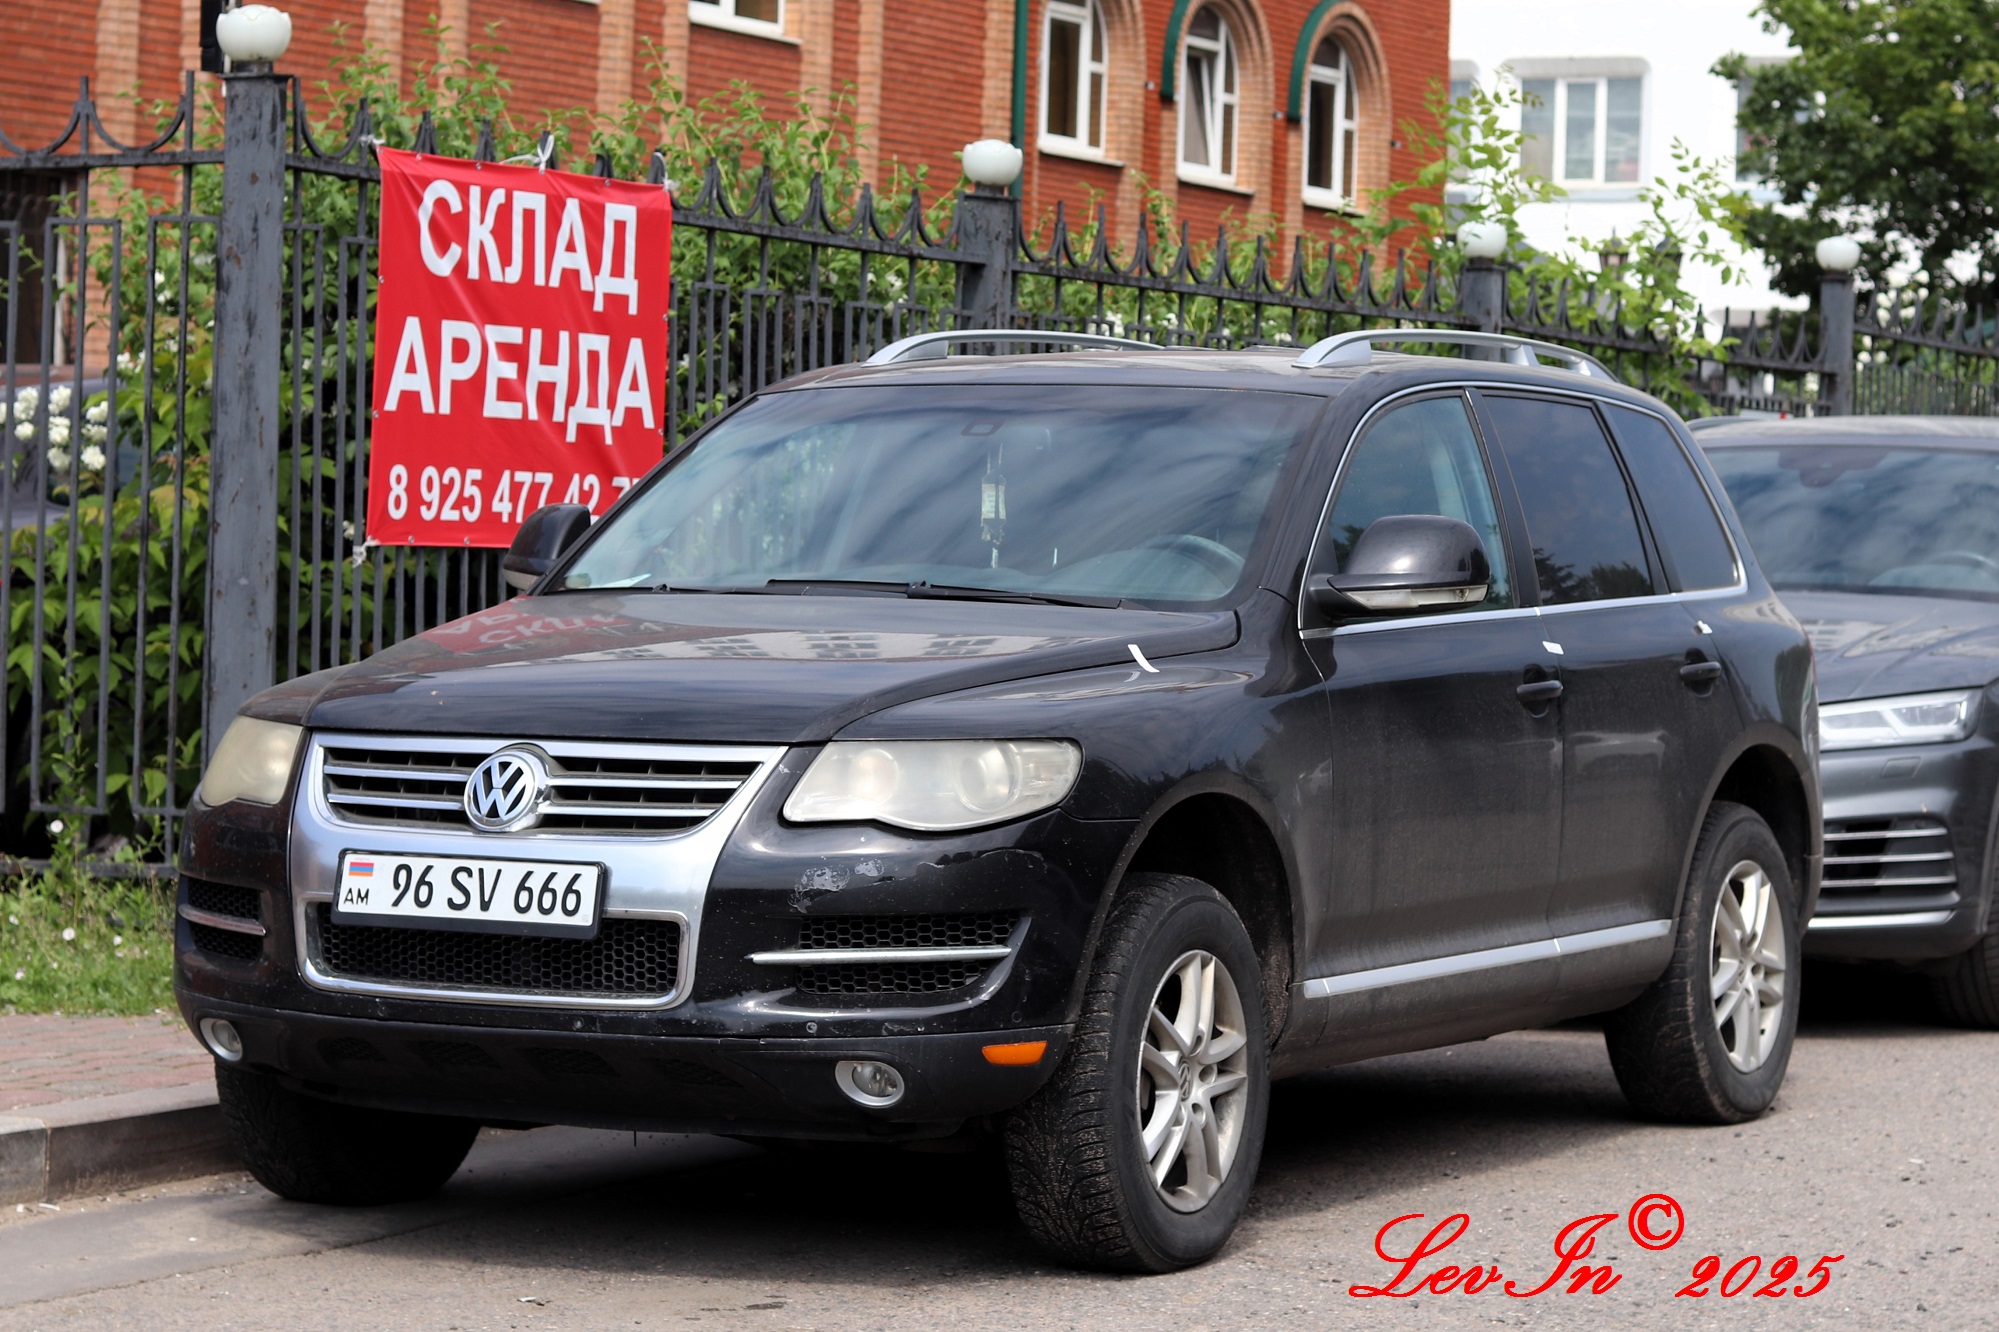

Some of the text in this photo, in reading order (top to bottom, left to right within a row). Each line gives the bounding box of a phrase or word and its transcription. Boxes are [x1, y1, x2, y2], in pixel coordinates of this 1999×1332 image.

[418, 179, 638, 315] СКЛАД
[383, 316, 655, 445] АРЕНДА
[387, 464, 408, 520] 8
[419, 465, 482, 523] 925
[491, 469, 553, 524] 477
[343, 887, 370, 906] AM
[391, 863, 582, 917] 96 SV 666
